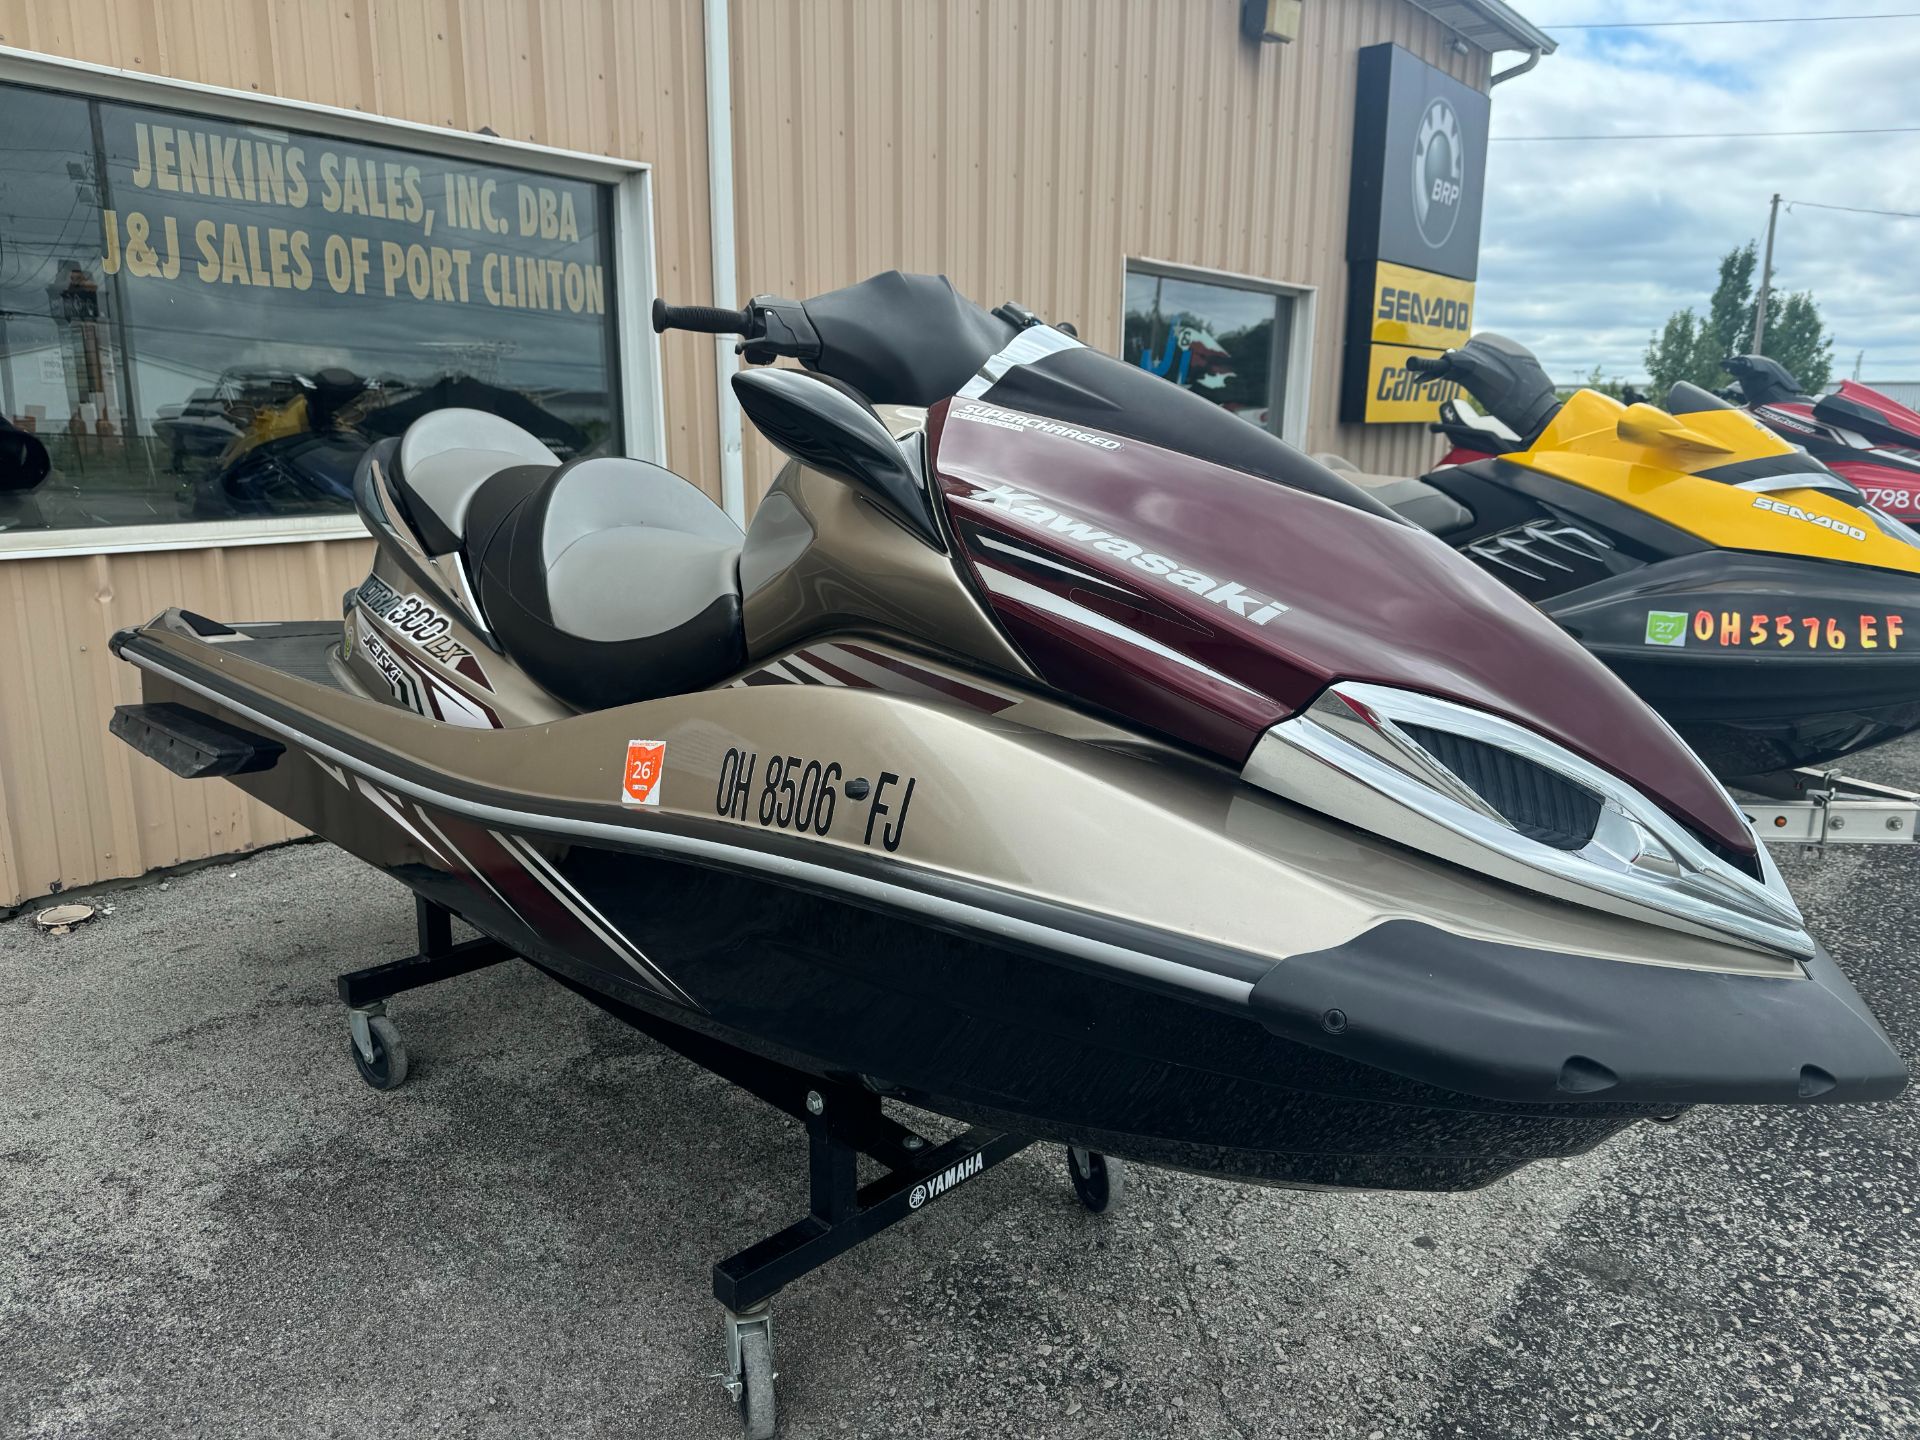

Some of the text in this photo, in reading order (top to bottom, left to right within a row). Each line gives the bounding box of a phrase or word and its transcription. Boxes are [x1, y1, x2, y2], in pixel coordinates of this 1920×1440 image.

[133, 122, 580, 243] JENKINS SALES, INC. DBA
[1431, 178, 1459, 206] BRP
[101, 209, 605, 315] J&J SALES OF PORT CLINTON
[958, 404, 1121, 450] SUPERCHARGED
[1858, 487, 1910, 509] 798
[970, 485, 1290, 626] Kawasaki
[1655, 622, 1676, 633] 27
[1693, 610, 1905, 650] OH 5576 EF
[632, 760, 652, 780] 26
[716, 747, 916, 853] OH 8506 FJ
[926, 1152, 984, 1199] YAMAHA
